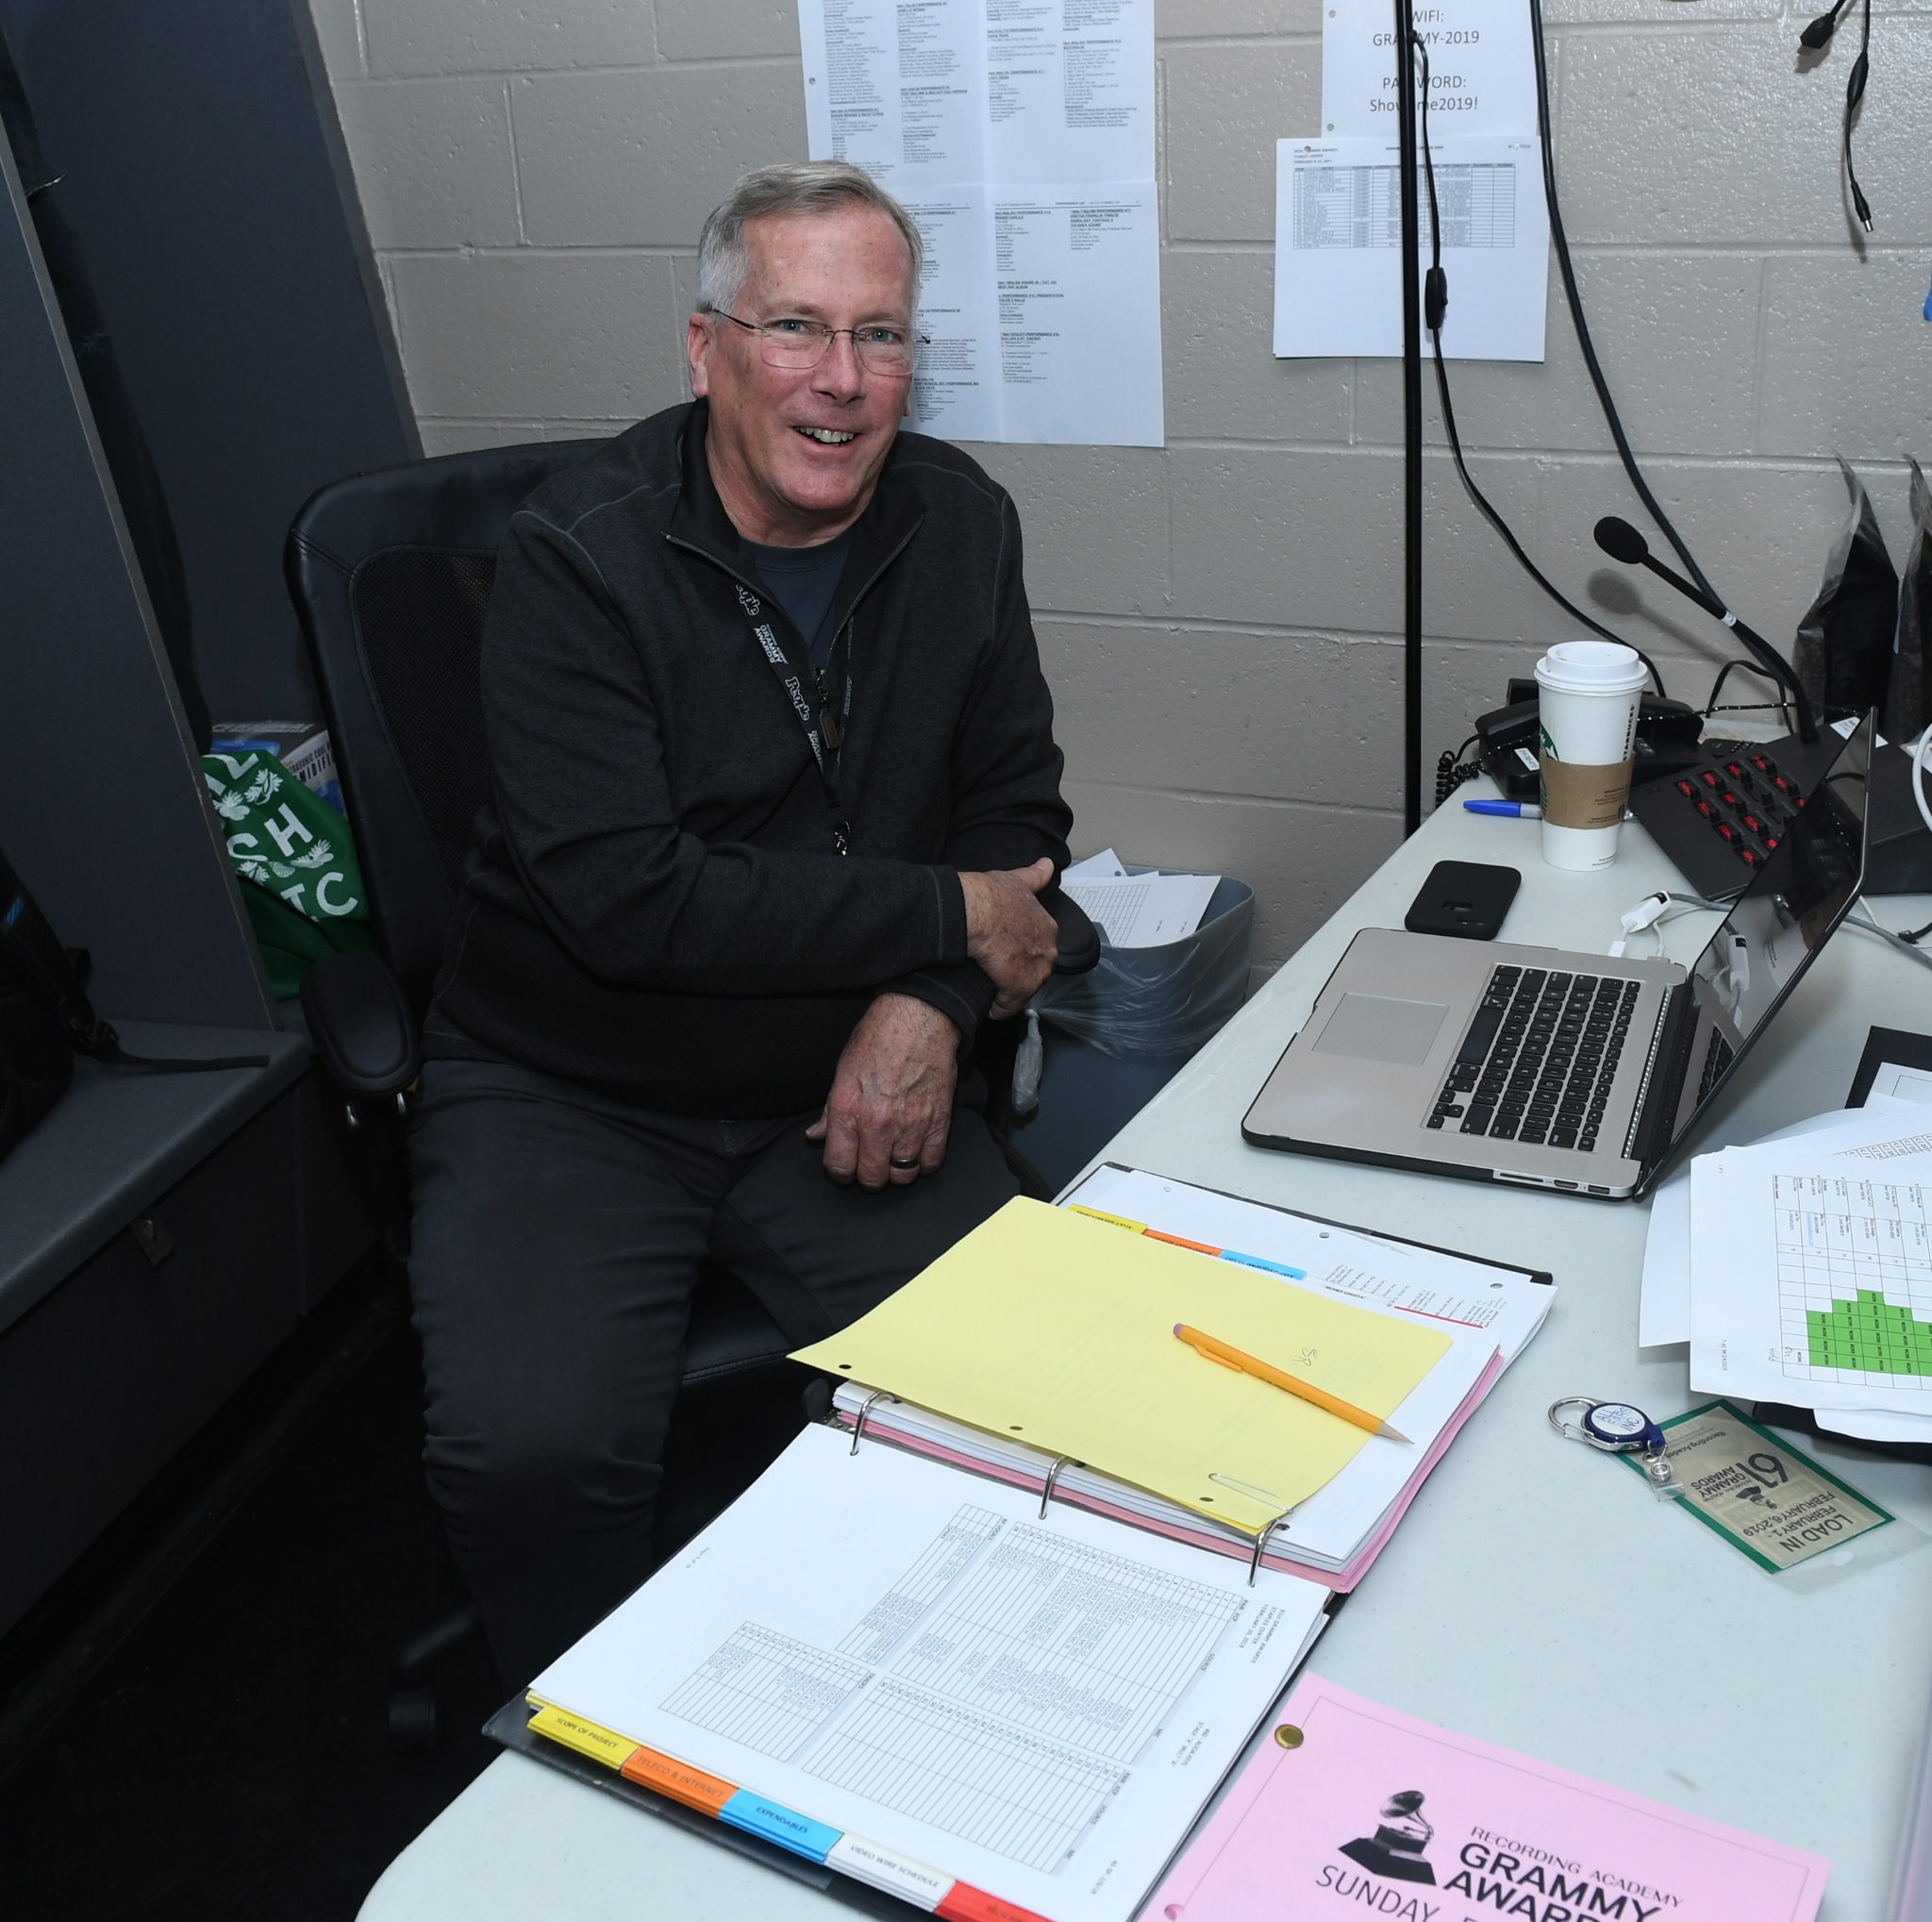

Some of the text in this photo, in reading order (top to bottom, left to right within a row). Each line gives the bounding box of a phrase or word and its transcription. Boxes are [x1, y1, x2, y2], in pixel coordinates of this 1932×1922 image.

[1373, 30, 1479, 46] GRMY-2019
[1383, 75, 1467, 90] PAWORD:
[1370, 96, 1478, 112] Shome2019!
[736, 584, 760, 616] ople
[753, 627, 776, 664] AWARDS
[758, 624, 784, 663] GRAMMY
[784, 676, 810, 722] People
[1623, 704, 1635, 761] STARBUCKS
[1594, 1409, 1617, 1422] ALL
[1688, 1429, 1727, 1450] Recording
[1690, 1465, 1739, 1491] AWARDS
[1698, 1472, 1747, 1499] GRAMMY
[1781, 1491, 1837, 1521] FEBRUARY
[1782, 1504, 1838, 1536] FEBRUARY
[1779, 1513, 1855, 1553] LOAD IN
[556, 1716, 618, 1749] SCOPE OF PROJECT
[756, 1806, 808, 1834] EXPENDABLES
[850, 1844, 939, 1888] VIDEO WIRE SCHEDULE
[1459, 1842, 1661, 1922] GRAMMY
[1471, 1826, 1684, 1908] RECORDING ACADEMY
[1442, 1870, 1601, 1922] AWAR
